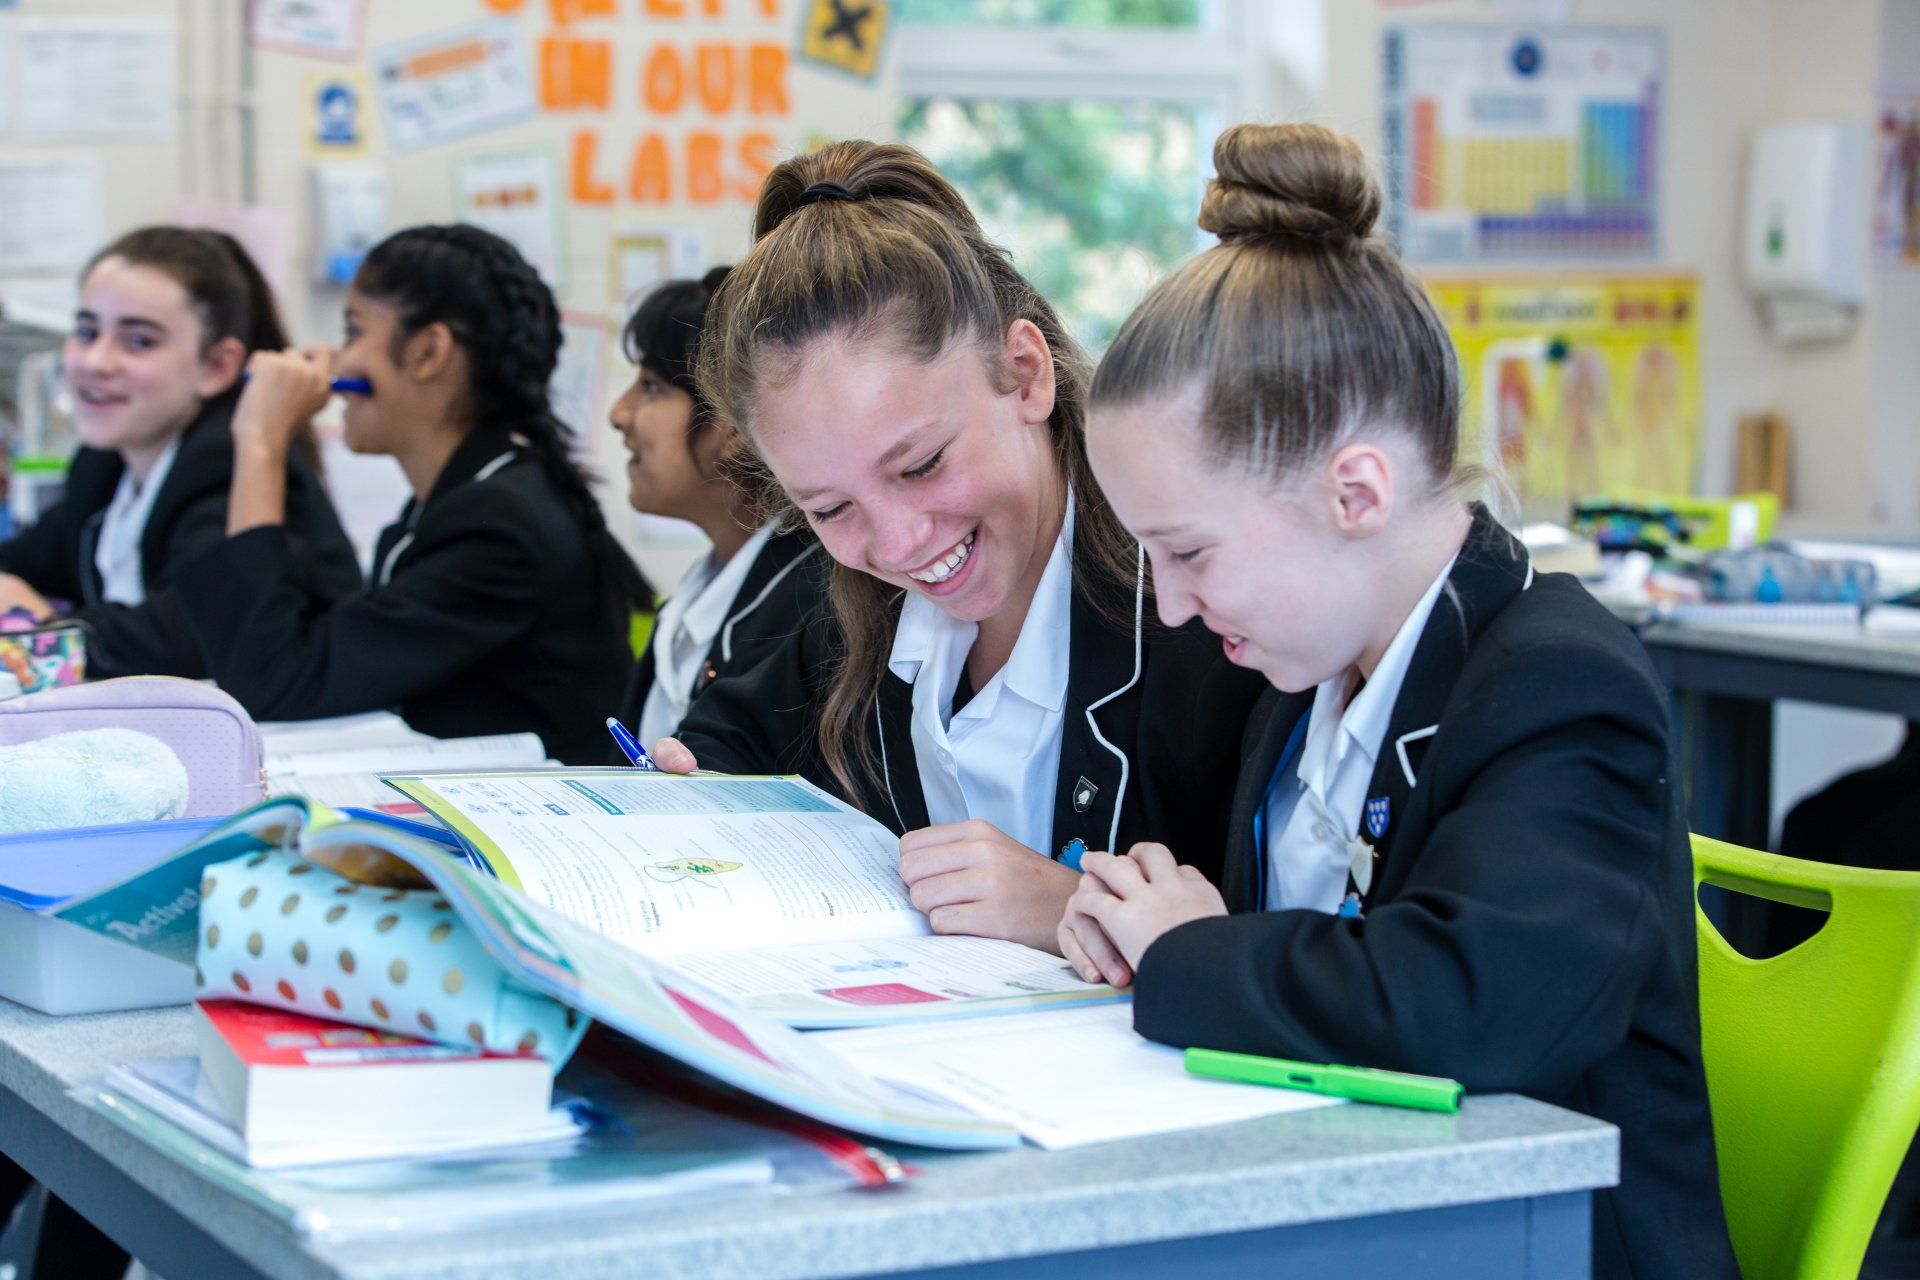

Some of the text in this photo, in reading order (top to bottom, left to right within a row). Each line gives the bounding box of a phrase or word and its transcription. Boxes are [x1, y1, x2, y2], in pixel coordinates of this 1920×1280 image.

[538, 37, 612, 115] IN
[641, 42, 791, 116] OUR
[570, 130, 776, 205] LABS
